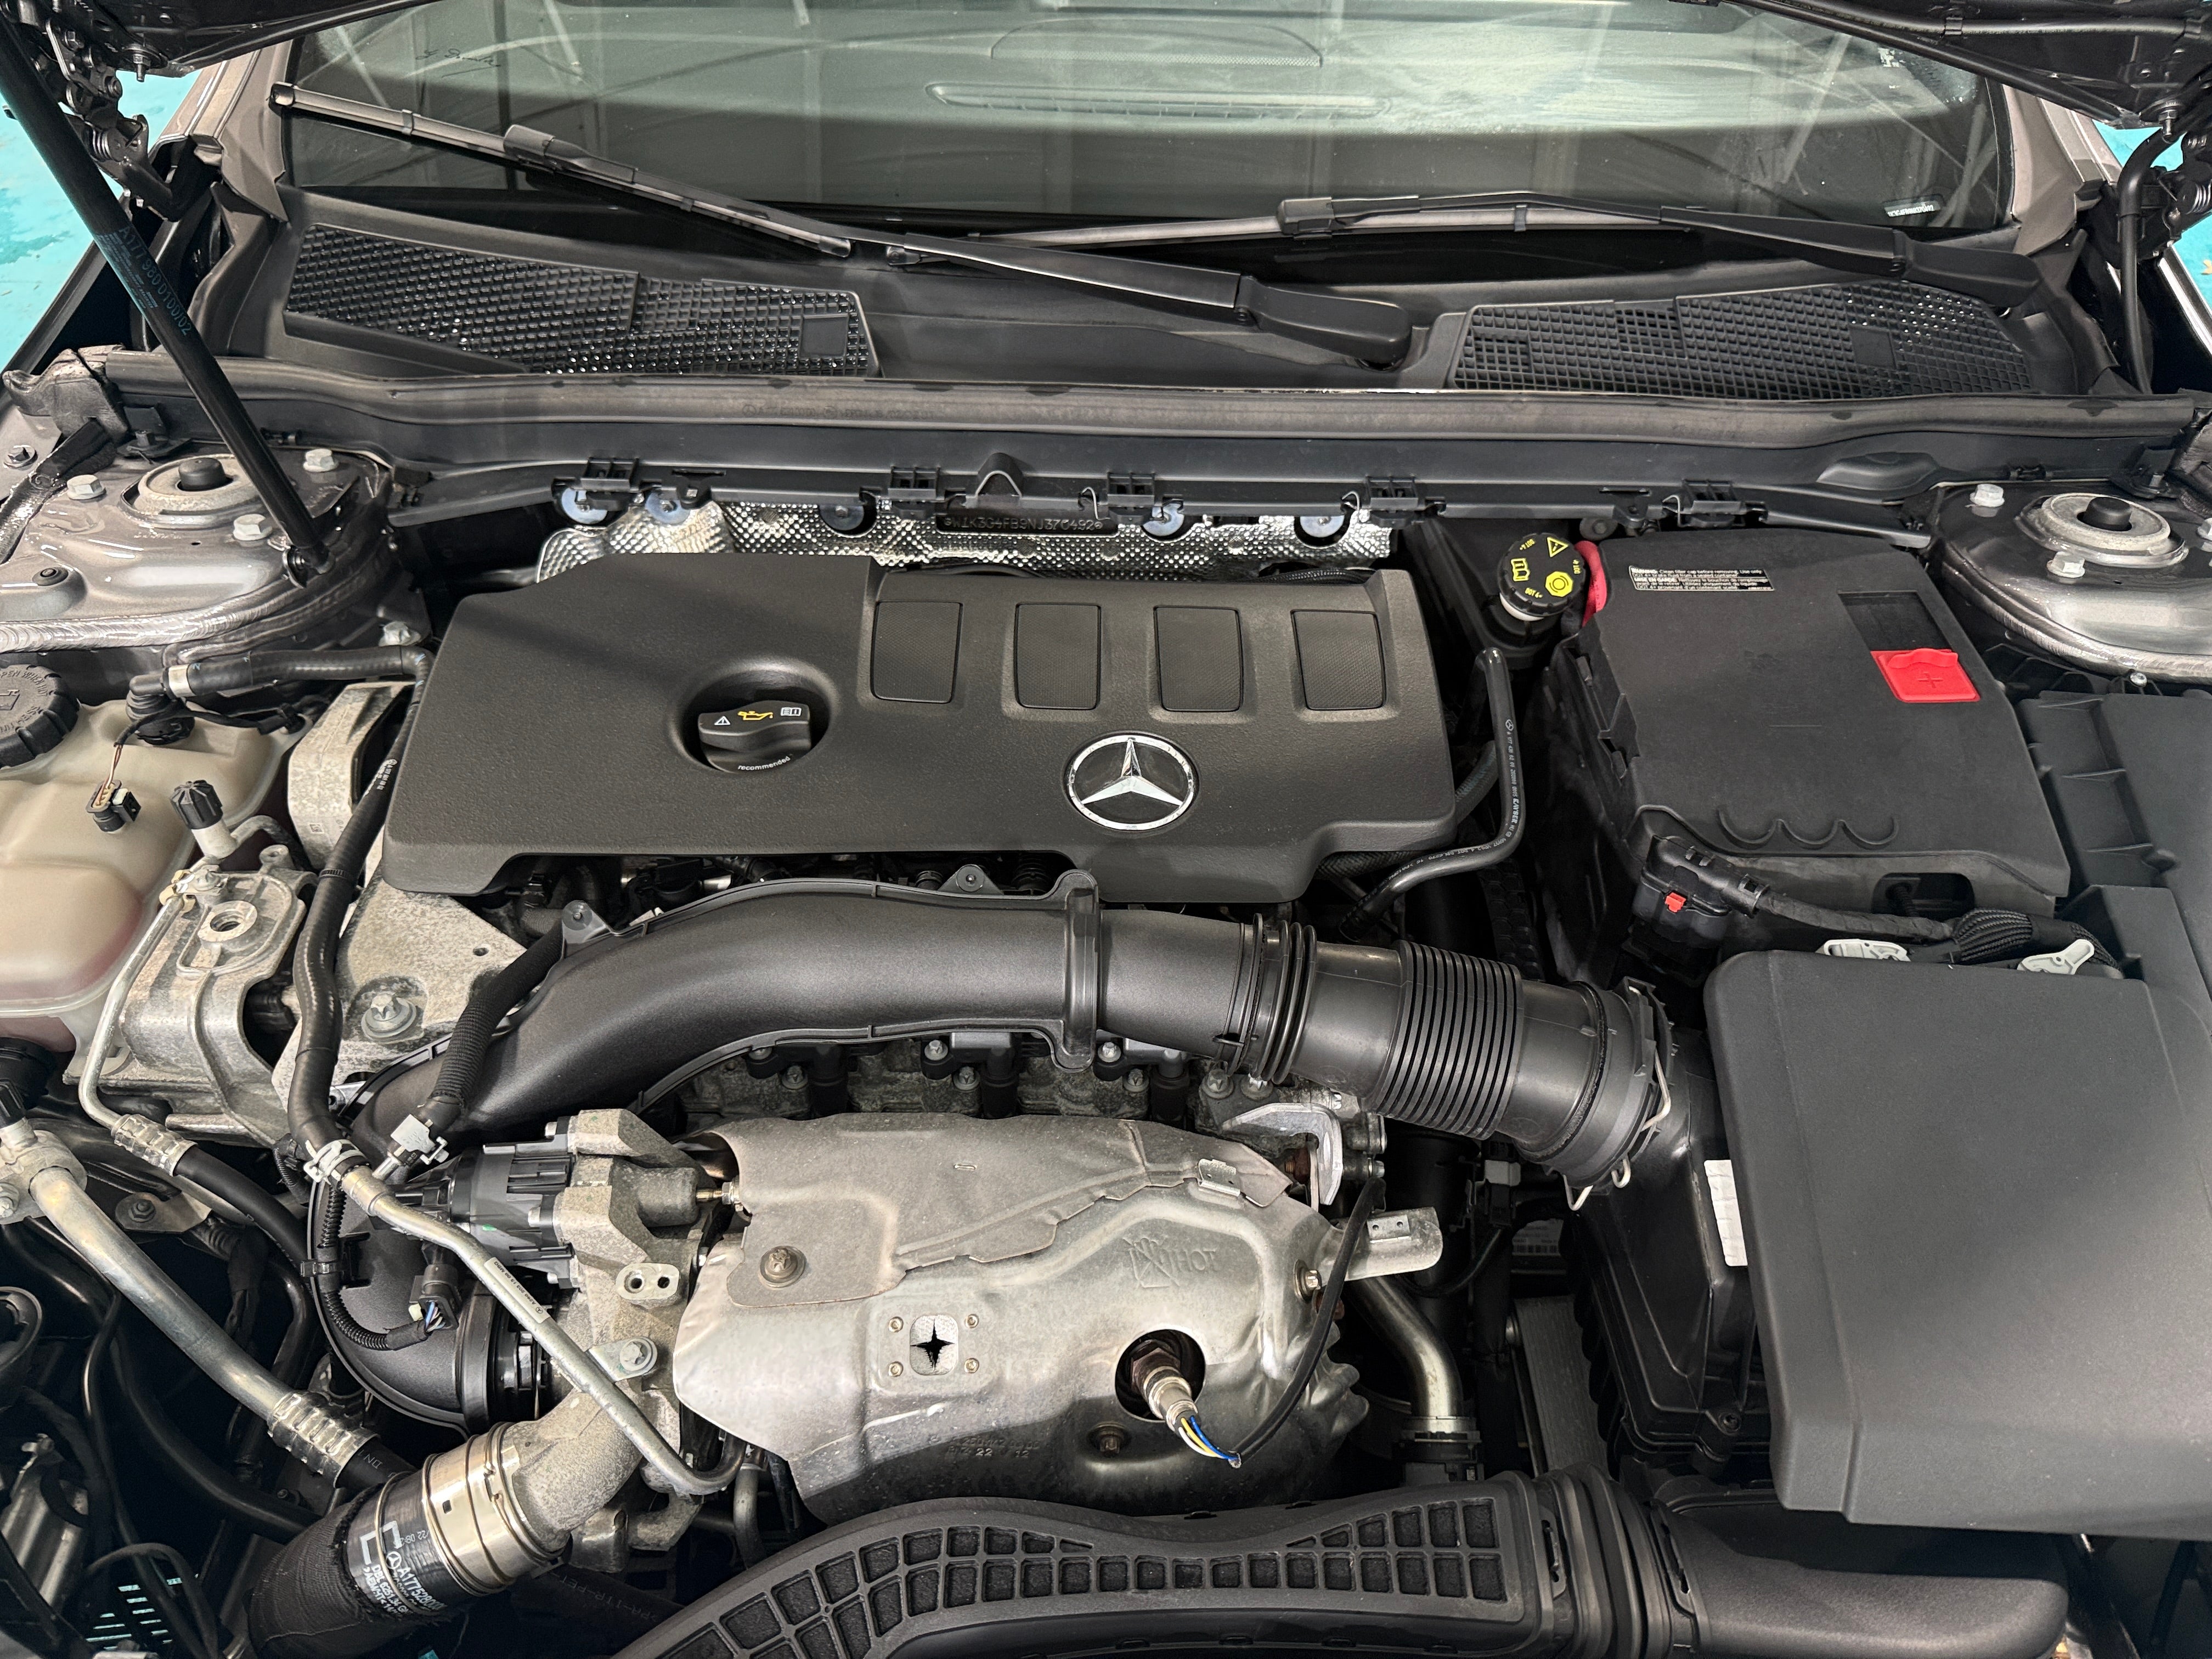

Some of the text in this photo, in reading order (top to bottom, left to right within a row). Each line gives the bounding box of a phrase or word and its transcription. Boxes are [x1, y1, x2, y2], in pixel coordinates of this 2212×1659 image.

[737, 756, 791, 771] recommended
[1176, 1247, 1218, 1272] HOT
[363, 1454, 382, 1470] DN
